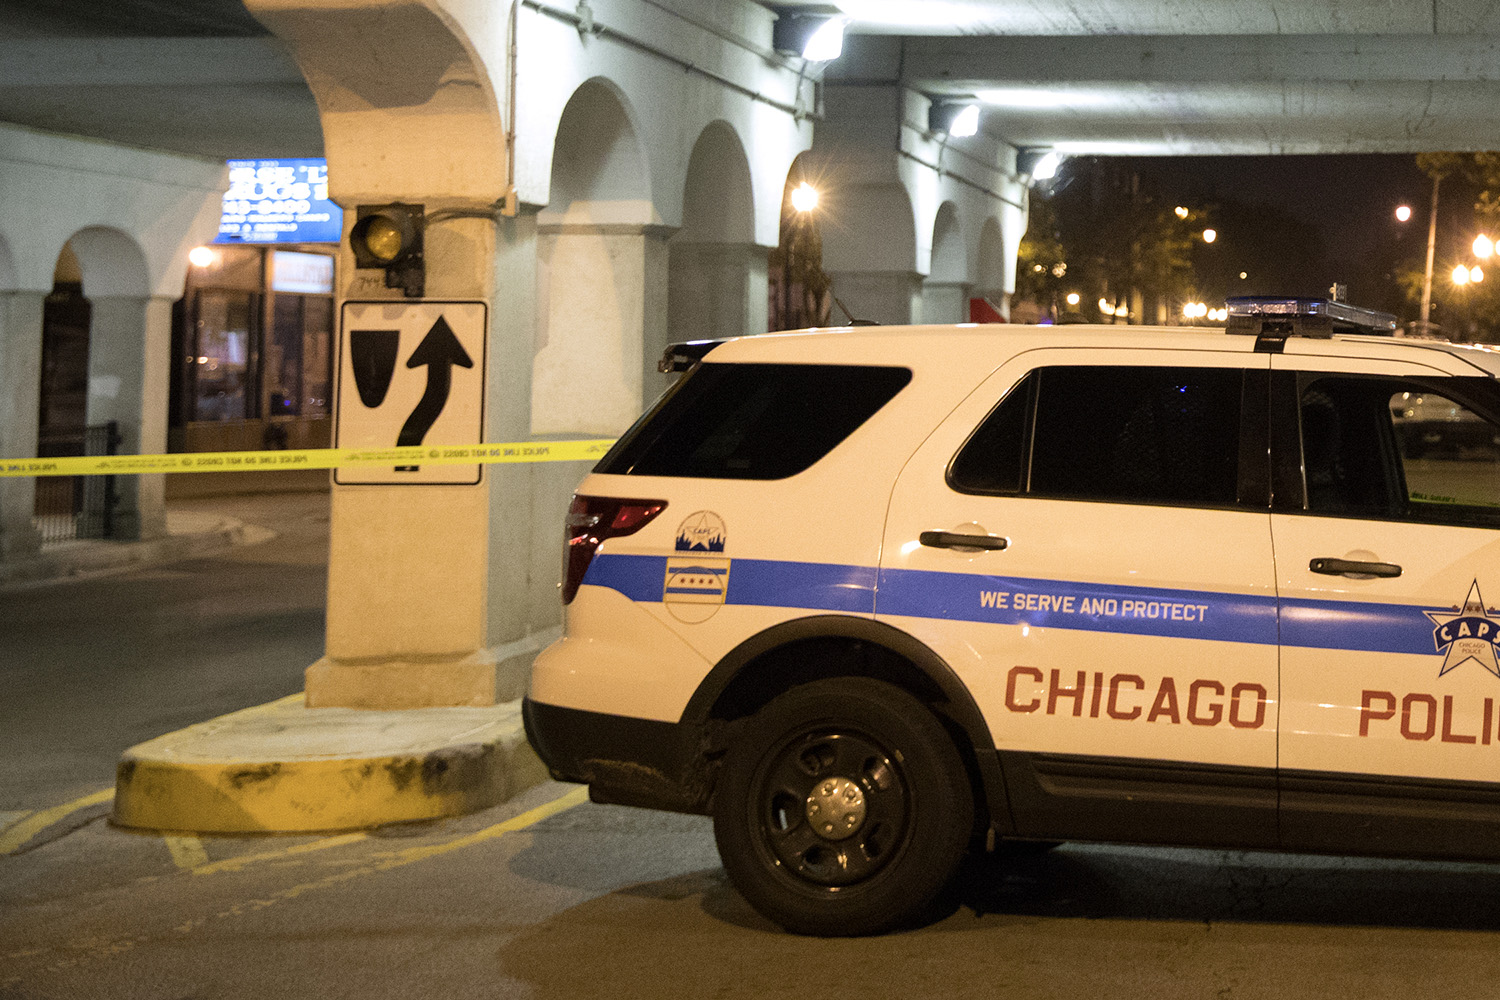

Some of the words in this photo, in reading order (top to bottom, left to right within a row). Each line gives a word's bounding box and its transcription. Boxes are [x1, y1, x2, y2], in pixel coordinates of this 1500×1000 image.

[980, 590, 1009, 610] WE
[1013, 592, 1076, 614] SERVE
[1079, 598, 1119, 616] AND
[1121, 600, 1209, 622] PROTECT
[1458, 641, 1486, 649] CHICAGO
[1004, 665, 1268, 730] CHICAGO
